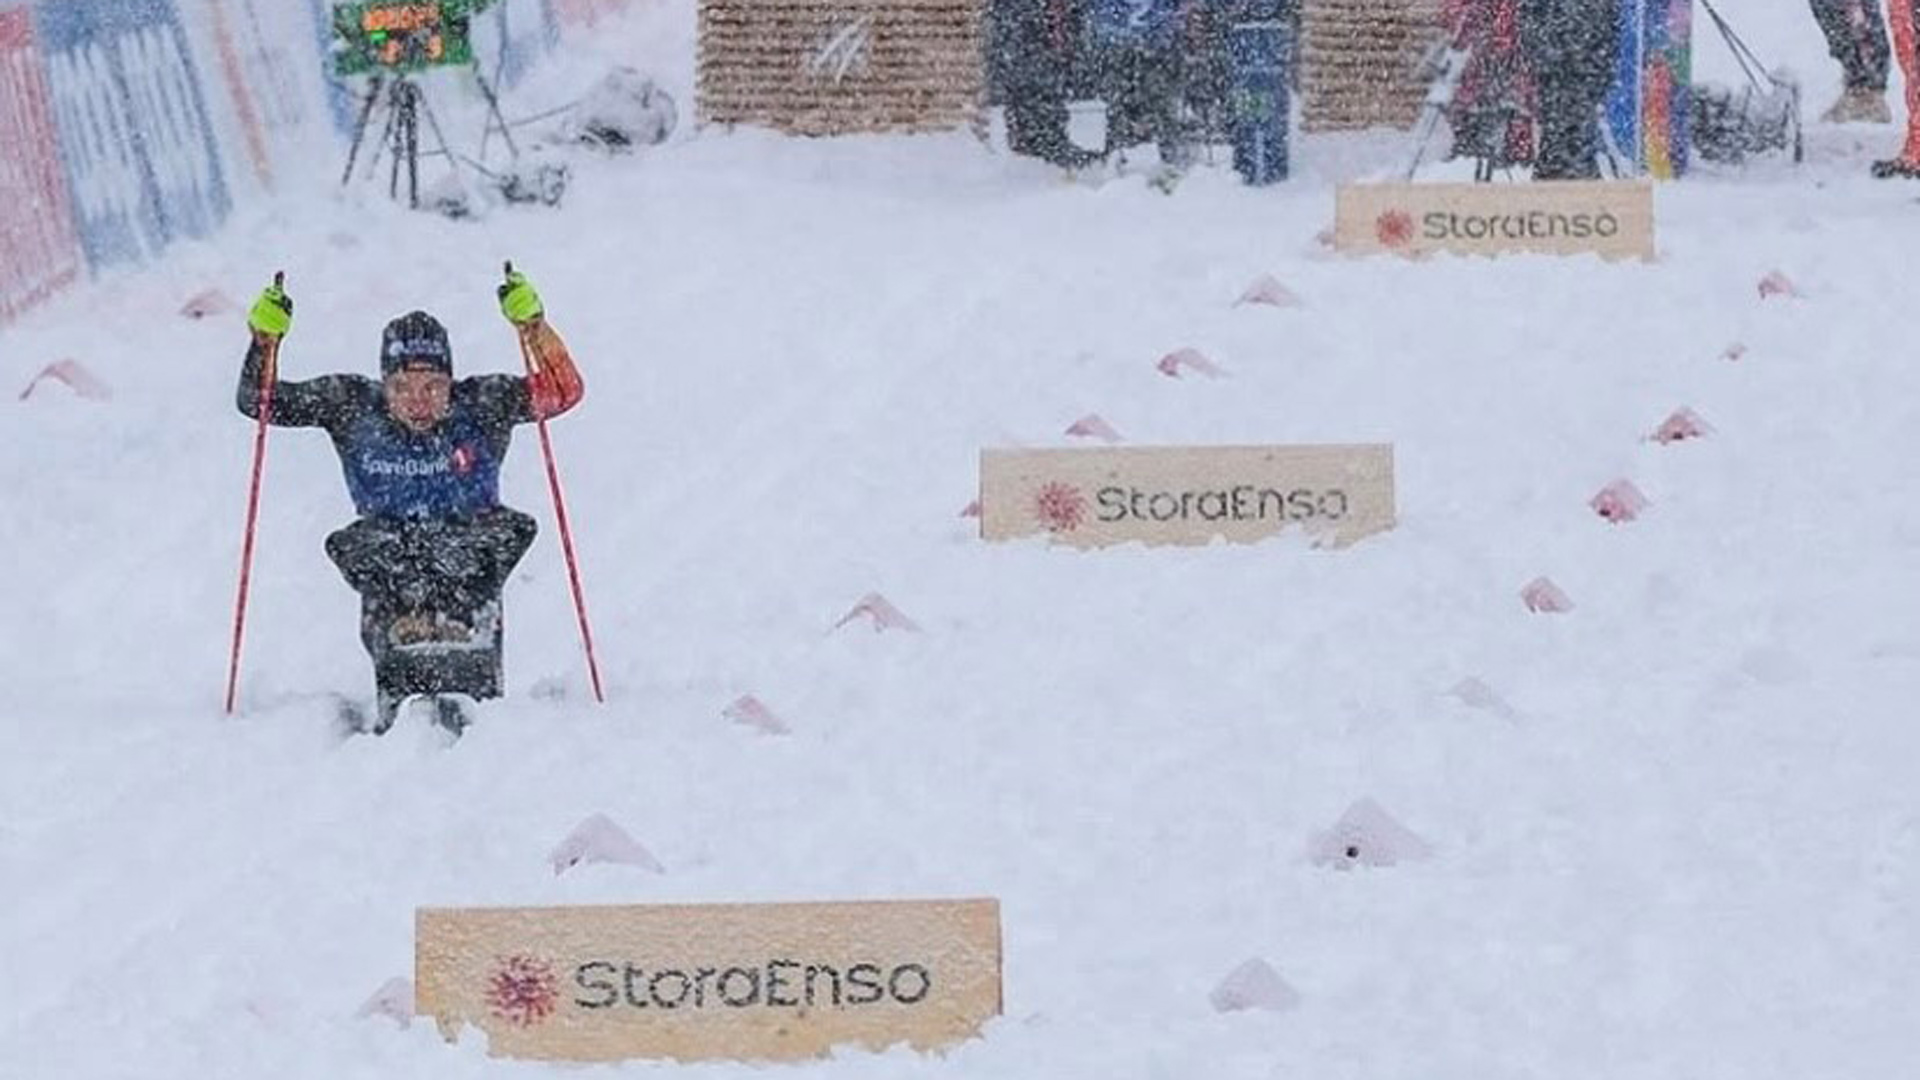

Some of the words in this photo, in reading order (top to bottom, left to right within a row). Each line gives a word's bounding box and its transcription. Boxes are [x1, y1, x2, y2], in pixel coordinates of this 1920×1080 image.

[1423, 210, 1619, 239] StoraEnso
[1096, 485, 1348, 522] StoraEnso
[574, 959, 932, 1009] StoraEnso
